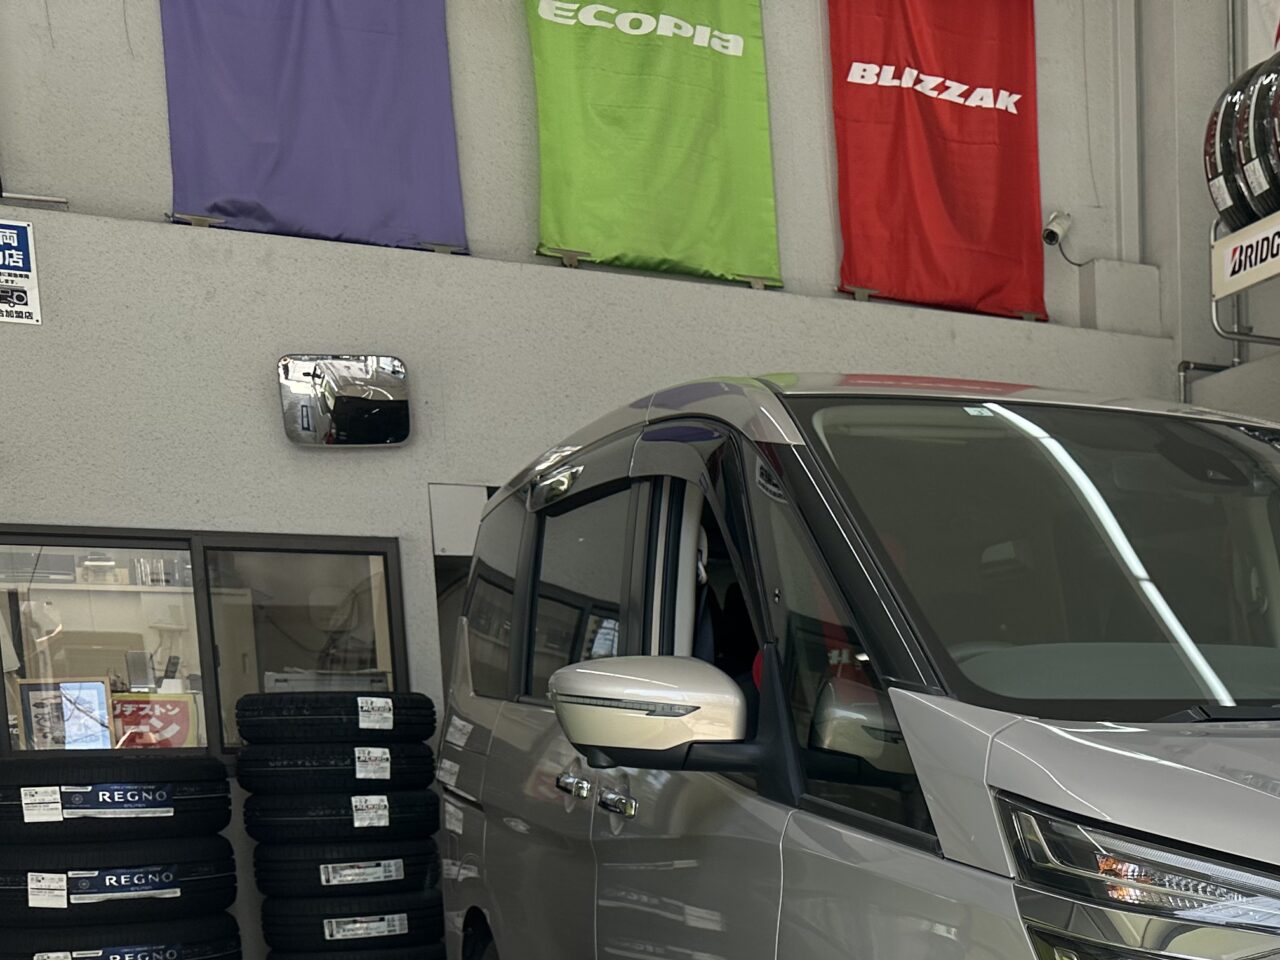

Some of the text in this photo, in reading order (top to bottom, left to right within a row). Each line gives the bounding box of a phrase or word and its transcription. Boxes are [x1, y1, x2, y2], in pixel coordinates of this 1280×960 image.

[846, 61, 1022, 115] BLIZZAK
[0, 250, 24, 267] 店
[99, 791, 168, 803] REGNO
[105, 872, 174, 886] REGNO
